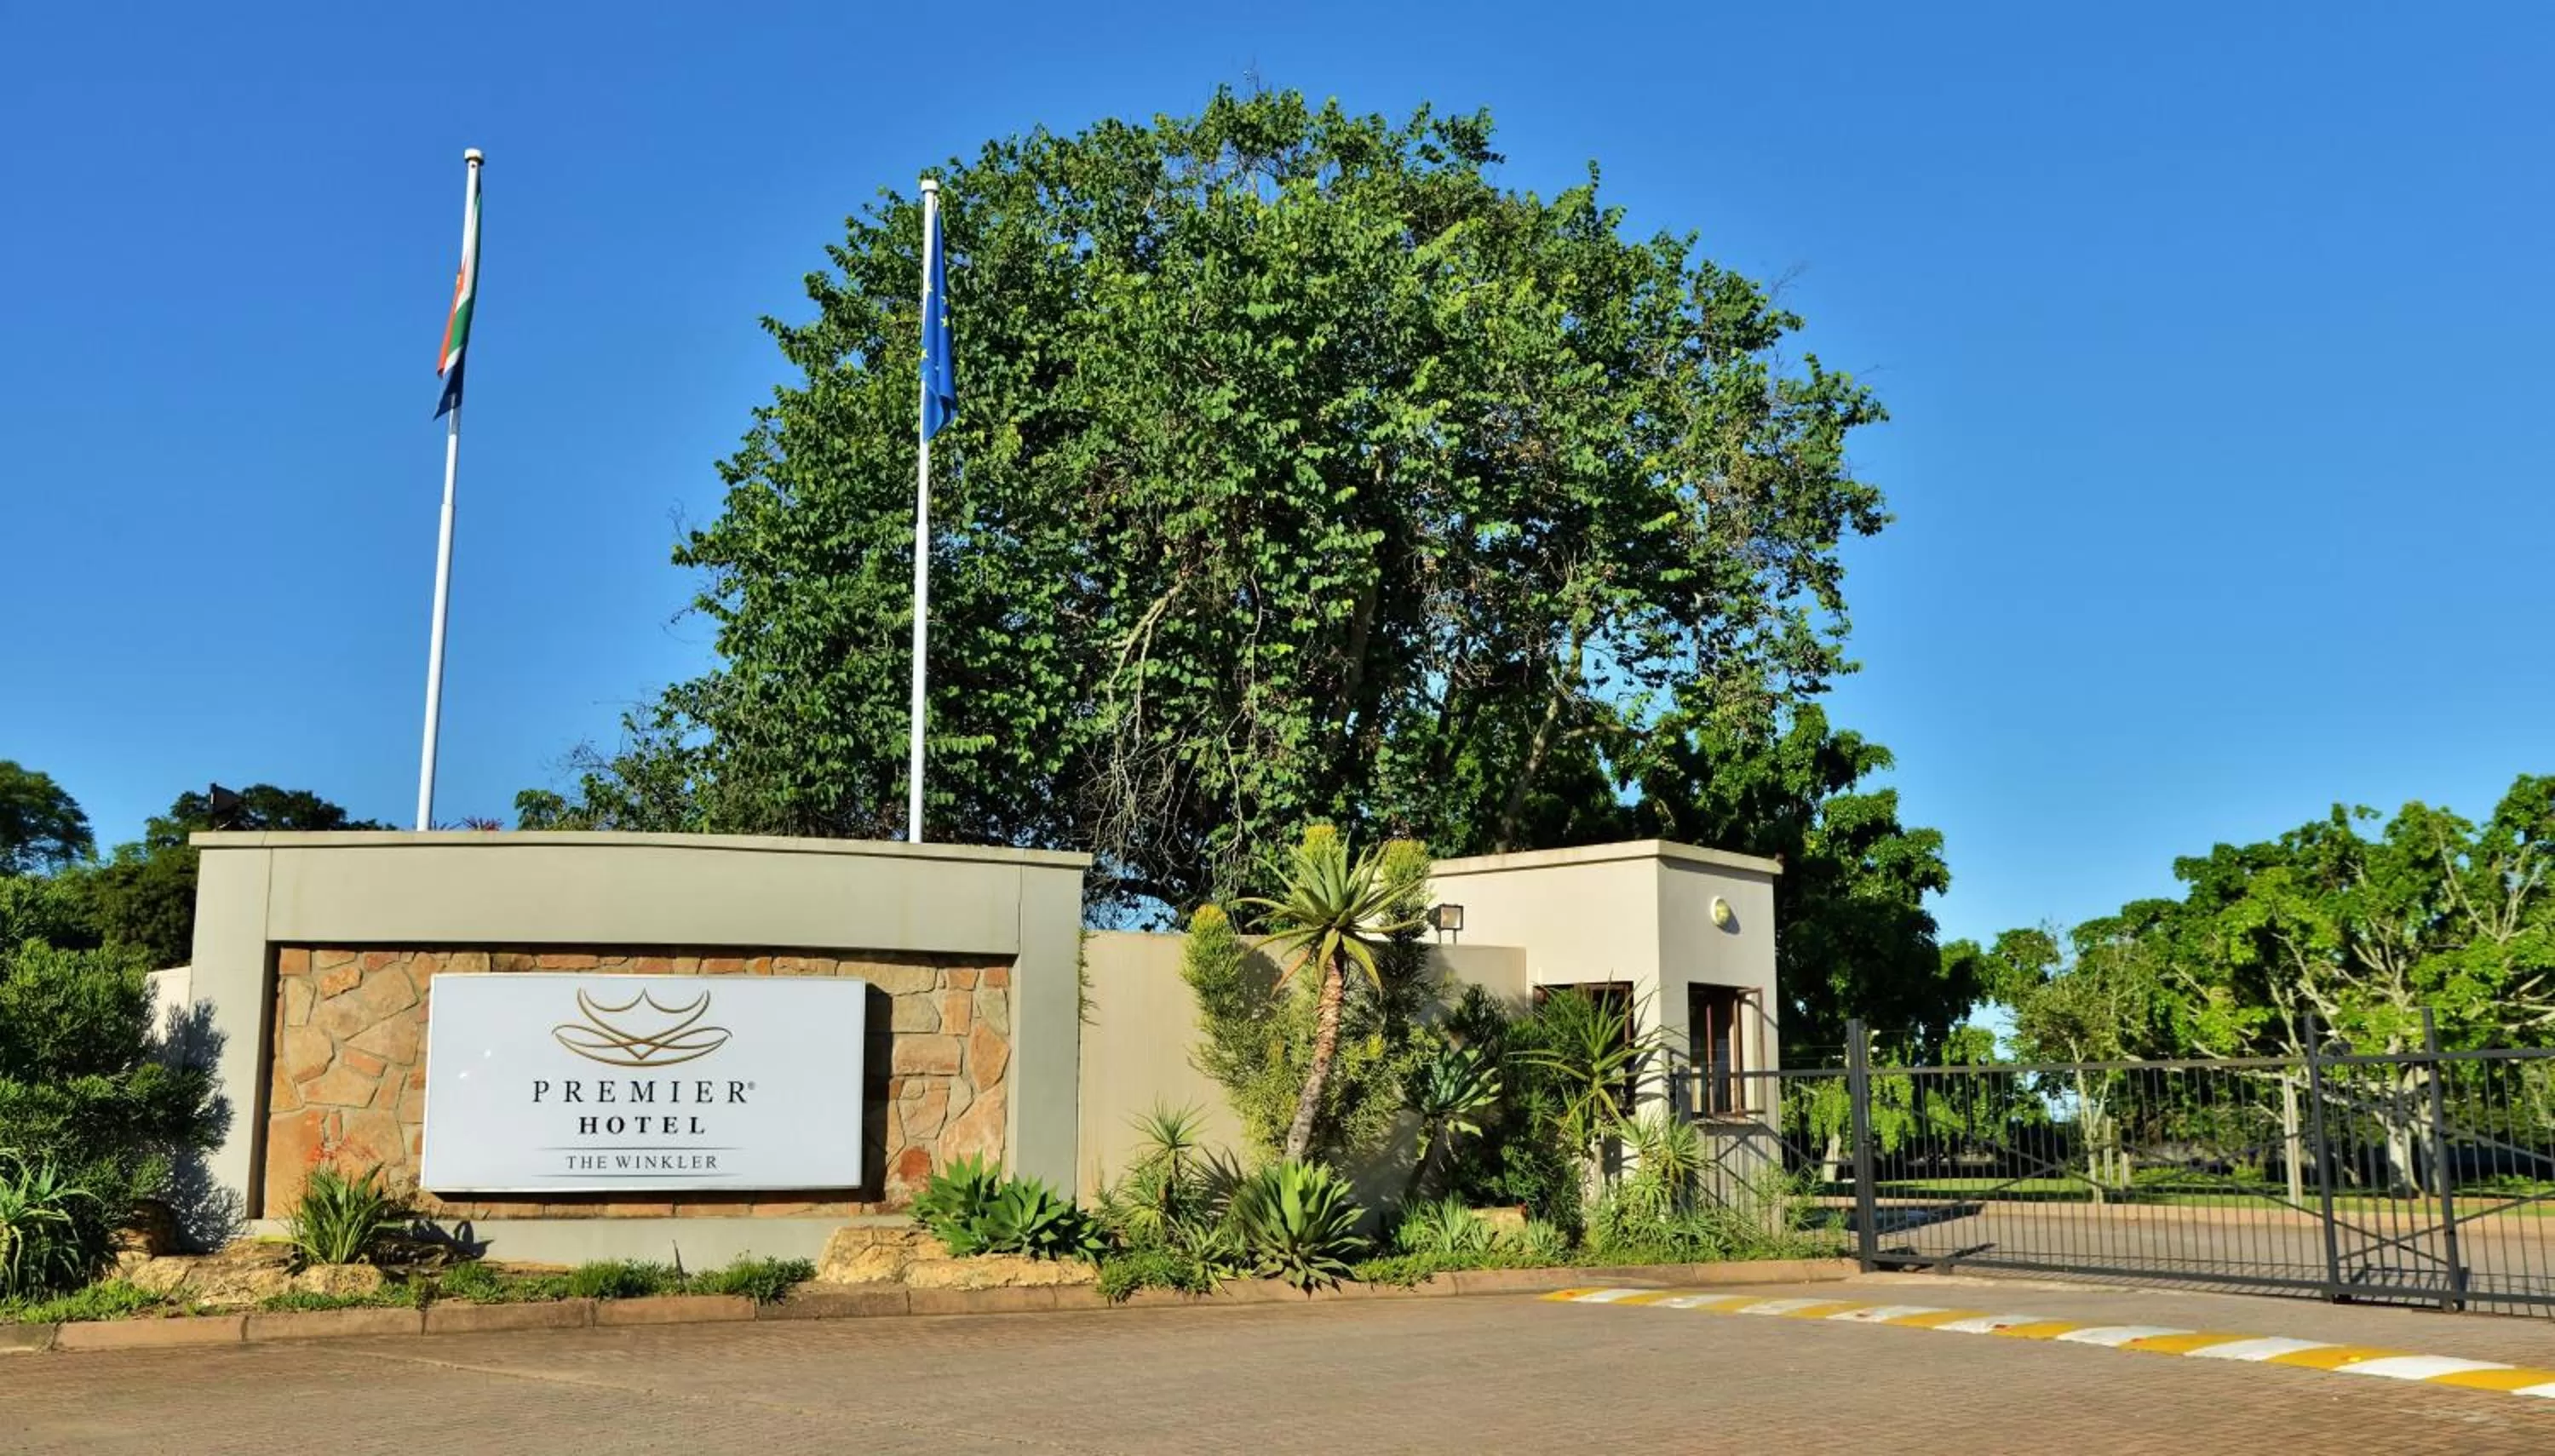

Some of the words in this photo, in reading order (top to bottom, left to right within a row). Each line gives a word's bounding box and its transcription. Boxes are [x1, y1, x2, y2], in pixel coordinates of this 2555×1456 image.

[531, 1080, 748, 1104] PREMIER
[578, 1115, 706, 1135] HOTEL
[566, 1155, 608, 1170] THE
[615, 1155, 719, 1170] WINKLER
